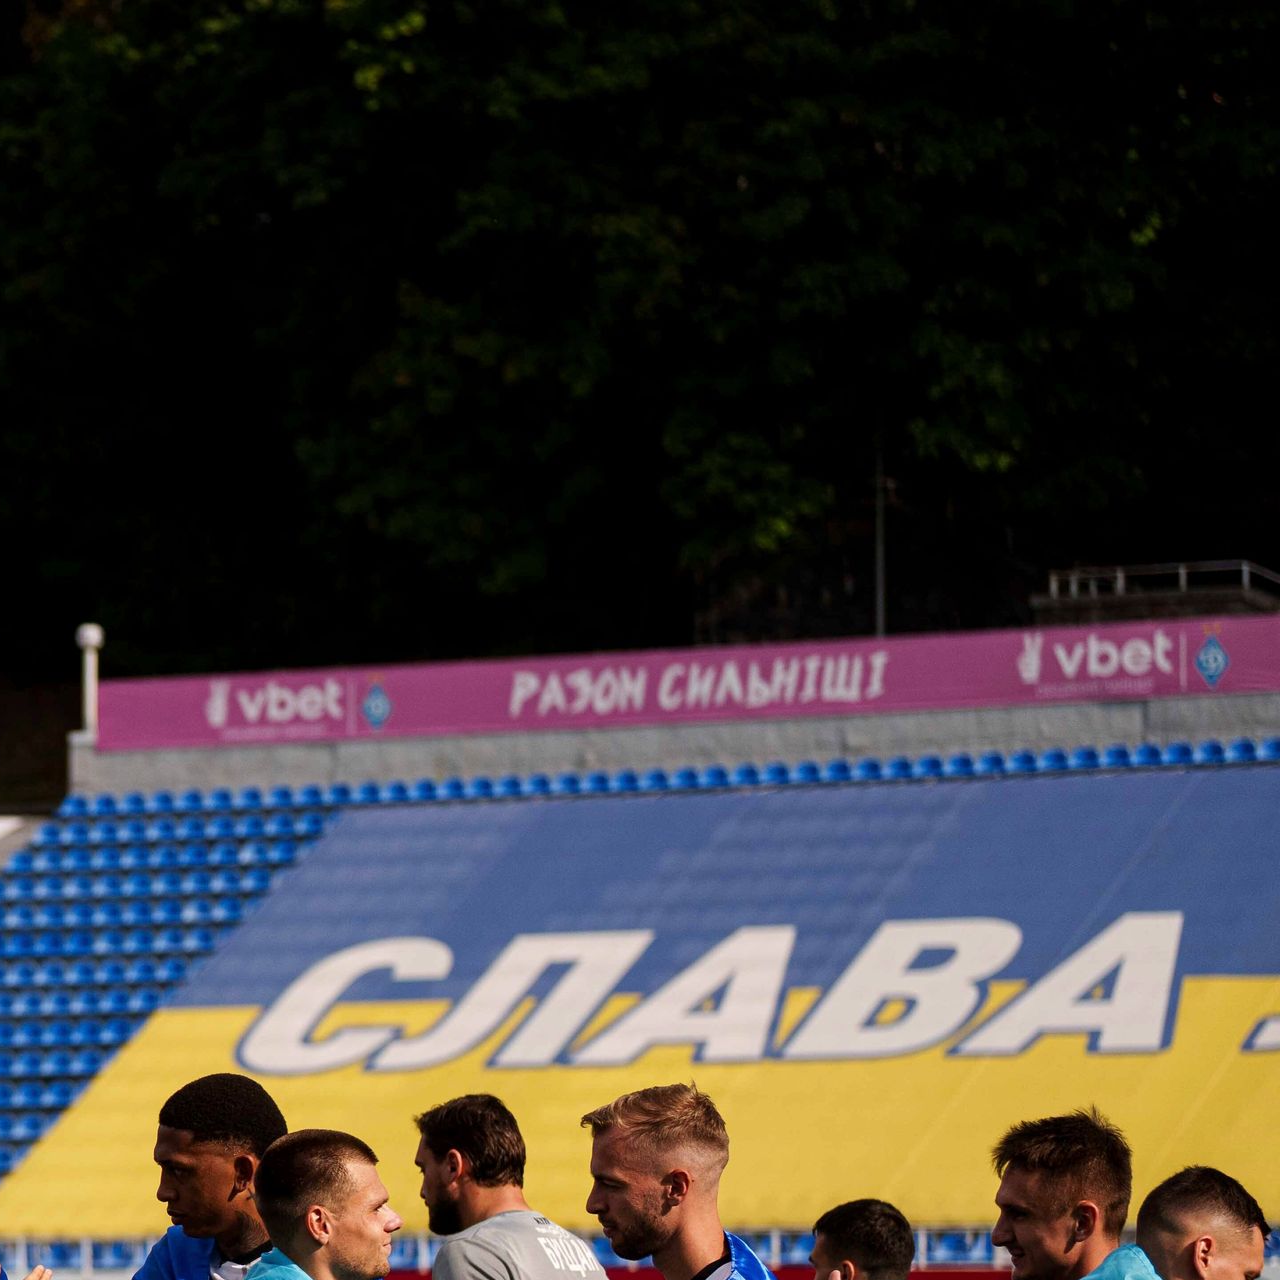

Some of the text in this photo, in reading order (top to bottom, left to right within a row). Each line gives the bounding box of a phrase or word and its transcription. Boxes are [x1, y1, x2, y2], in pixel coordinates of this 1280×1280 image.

[1053, 629, 1174, 680] vbet
[237, 677, 344, 723] vbet
[238, 910, 1184, 1075] СЛАВА
